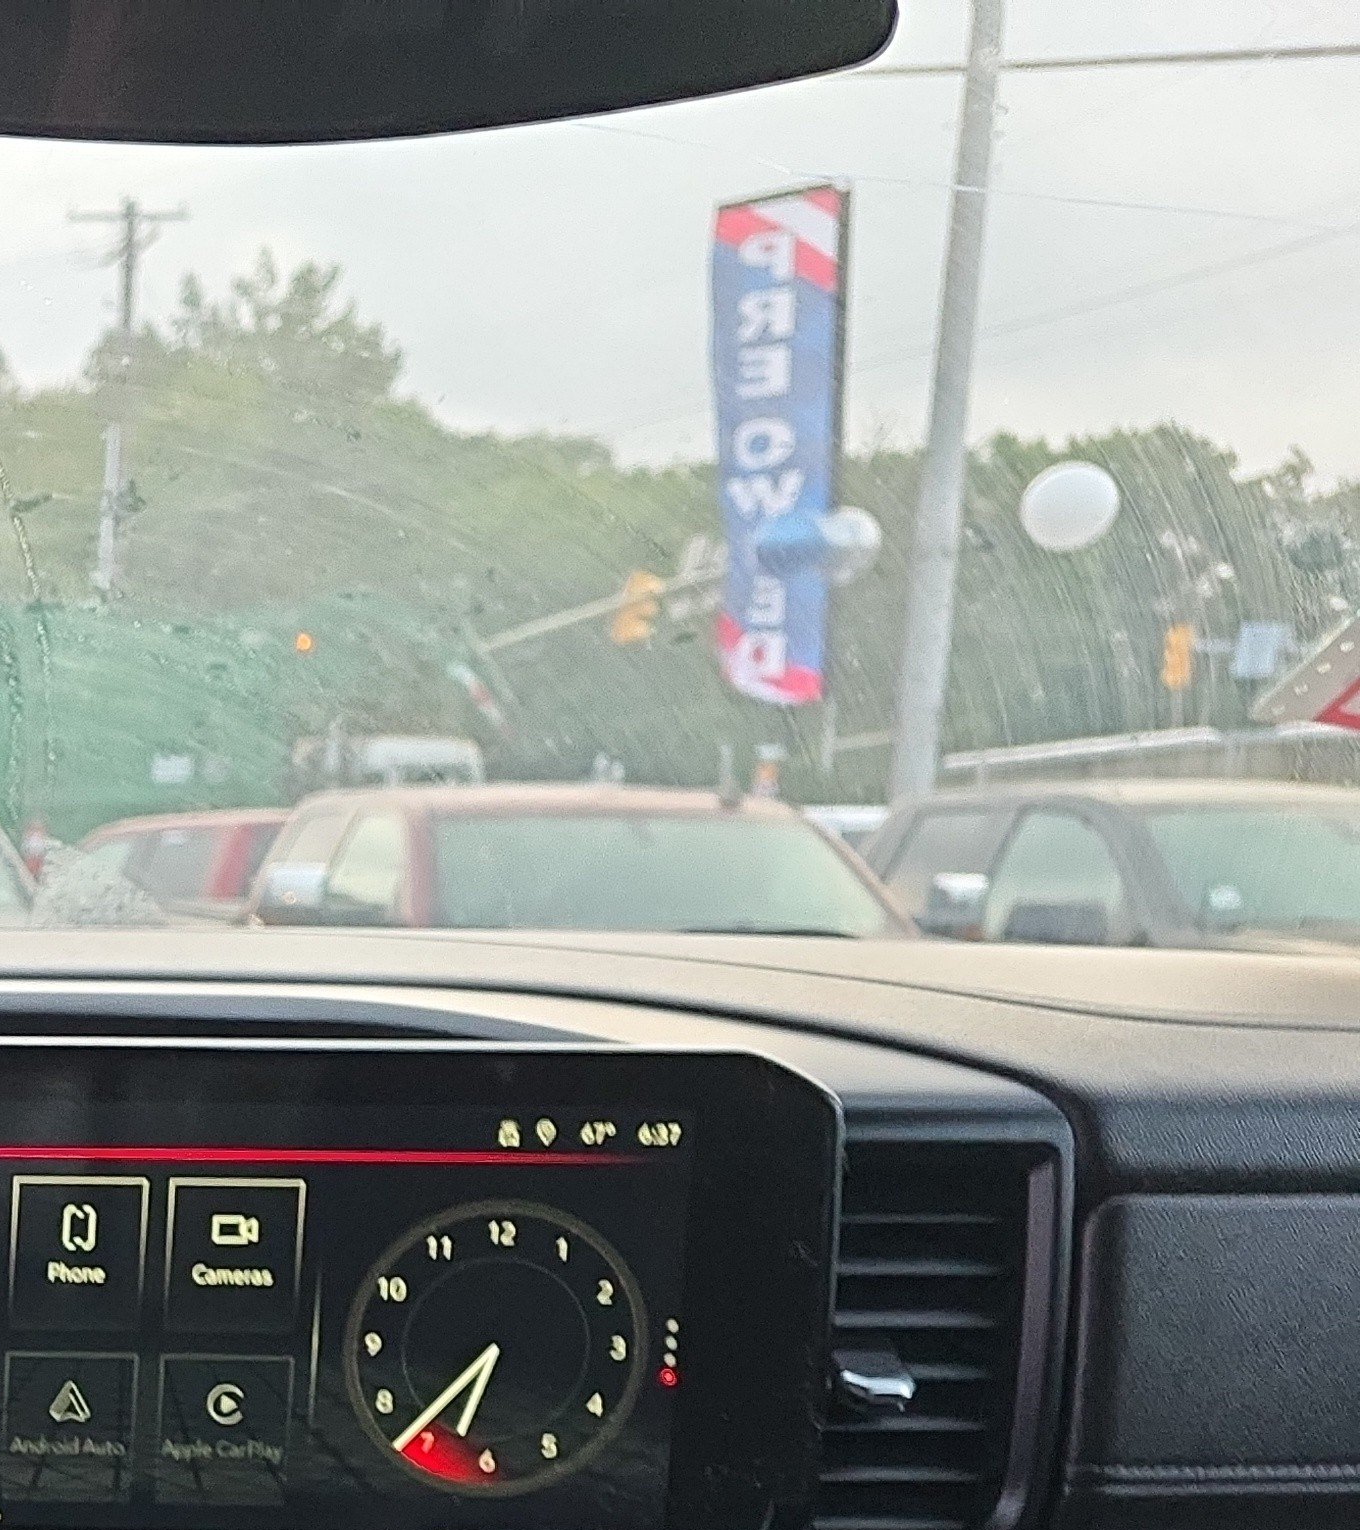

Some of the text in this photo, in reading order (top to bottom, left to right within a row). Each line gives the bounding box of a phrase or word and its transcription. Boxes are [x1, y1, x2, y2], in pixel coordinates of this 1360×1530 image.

[488, 1220, 517, 1246] 12
[426, 1235, 452, 1260] 11
[556, 1237, 568, 1262] 1
[47, 1261, 106, 1283] Phone
[191, 1263, 274, 1287] Cameras
[378, 1277, 408, 1301] 10
[596, 1280, 614, 1305] 2
[364, 1332, 383, 1357] 9
[609, 1335, 627, 1361] 3
[375, 1388, 394, 1415] 8
